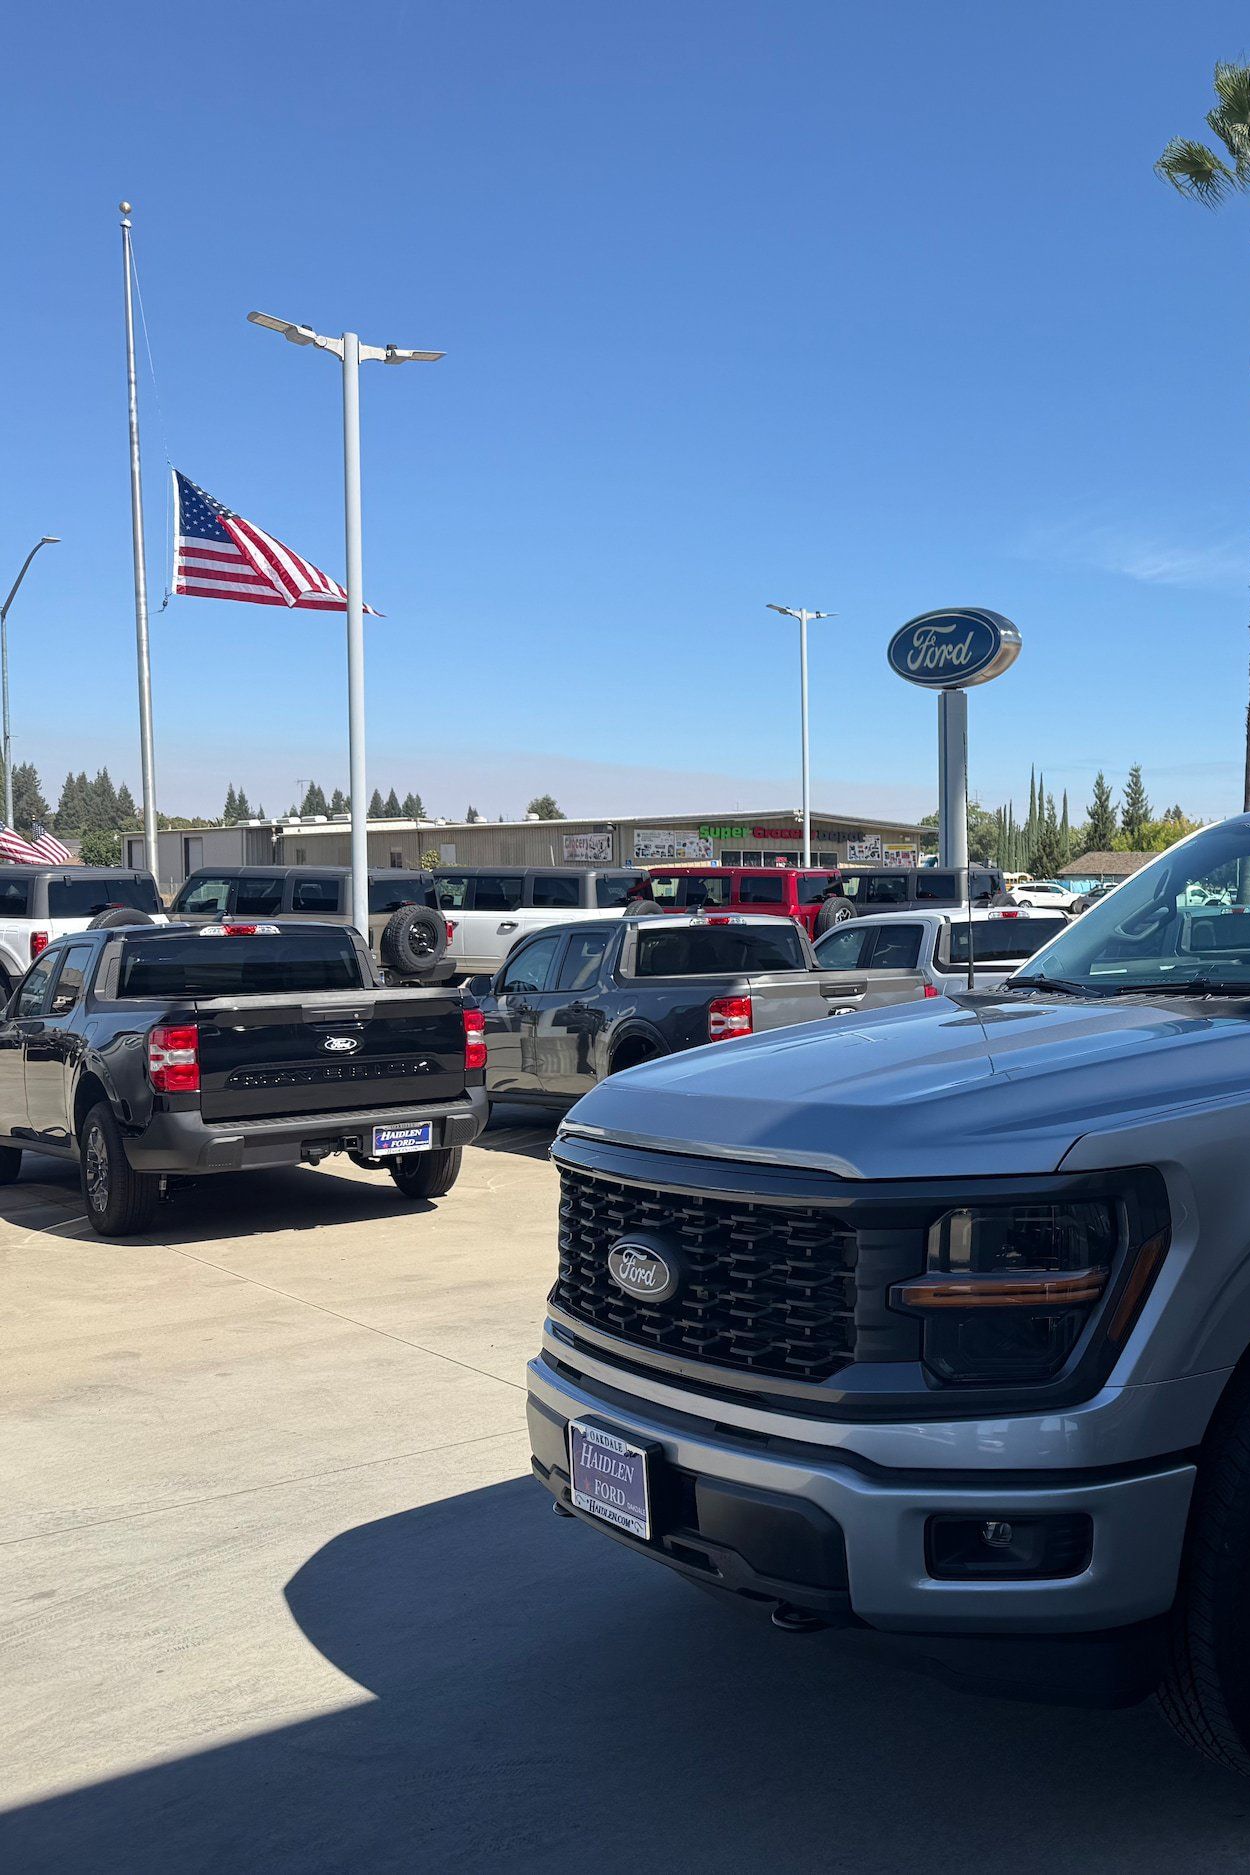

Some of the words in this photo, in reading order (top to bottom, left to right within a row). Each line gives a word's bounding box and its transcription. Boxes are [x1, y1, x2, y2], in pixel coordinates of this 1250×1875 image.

[907, 624, 974, 671] Ford
[699, 825, 748, 839] Super
[380, 1129, 422, 1141] HAIDLEN
[391, 1139, 415, 1148] FORD
[620, 1249, 656, 1287] Ford
[589, 1431, 624, 1452] OAKDALE
[579, 1442, 635, 1484] HAIDLEN
[594, 1478, 626, 1506] FORD
